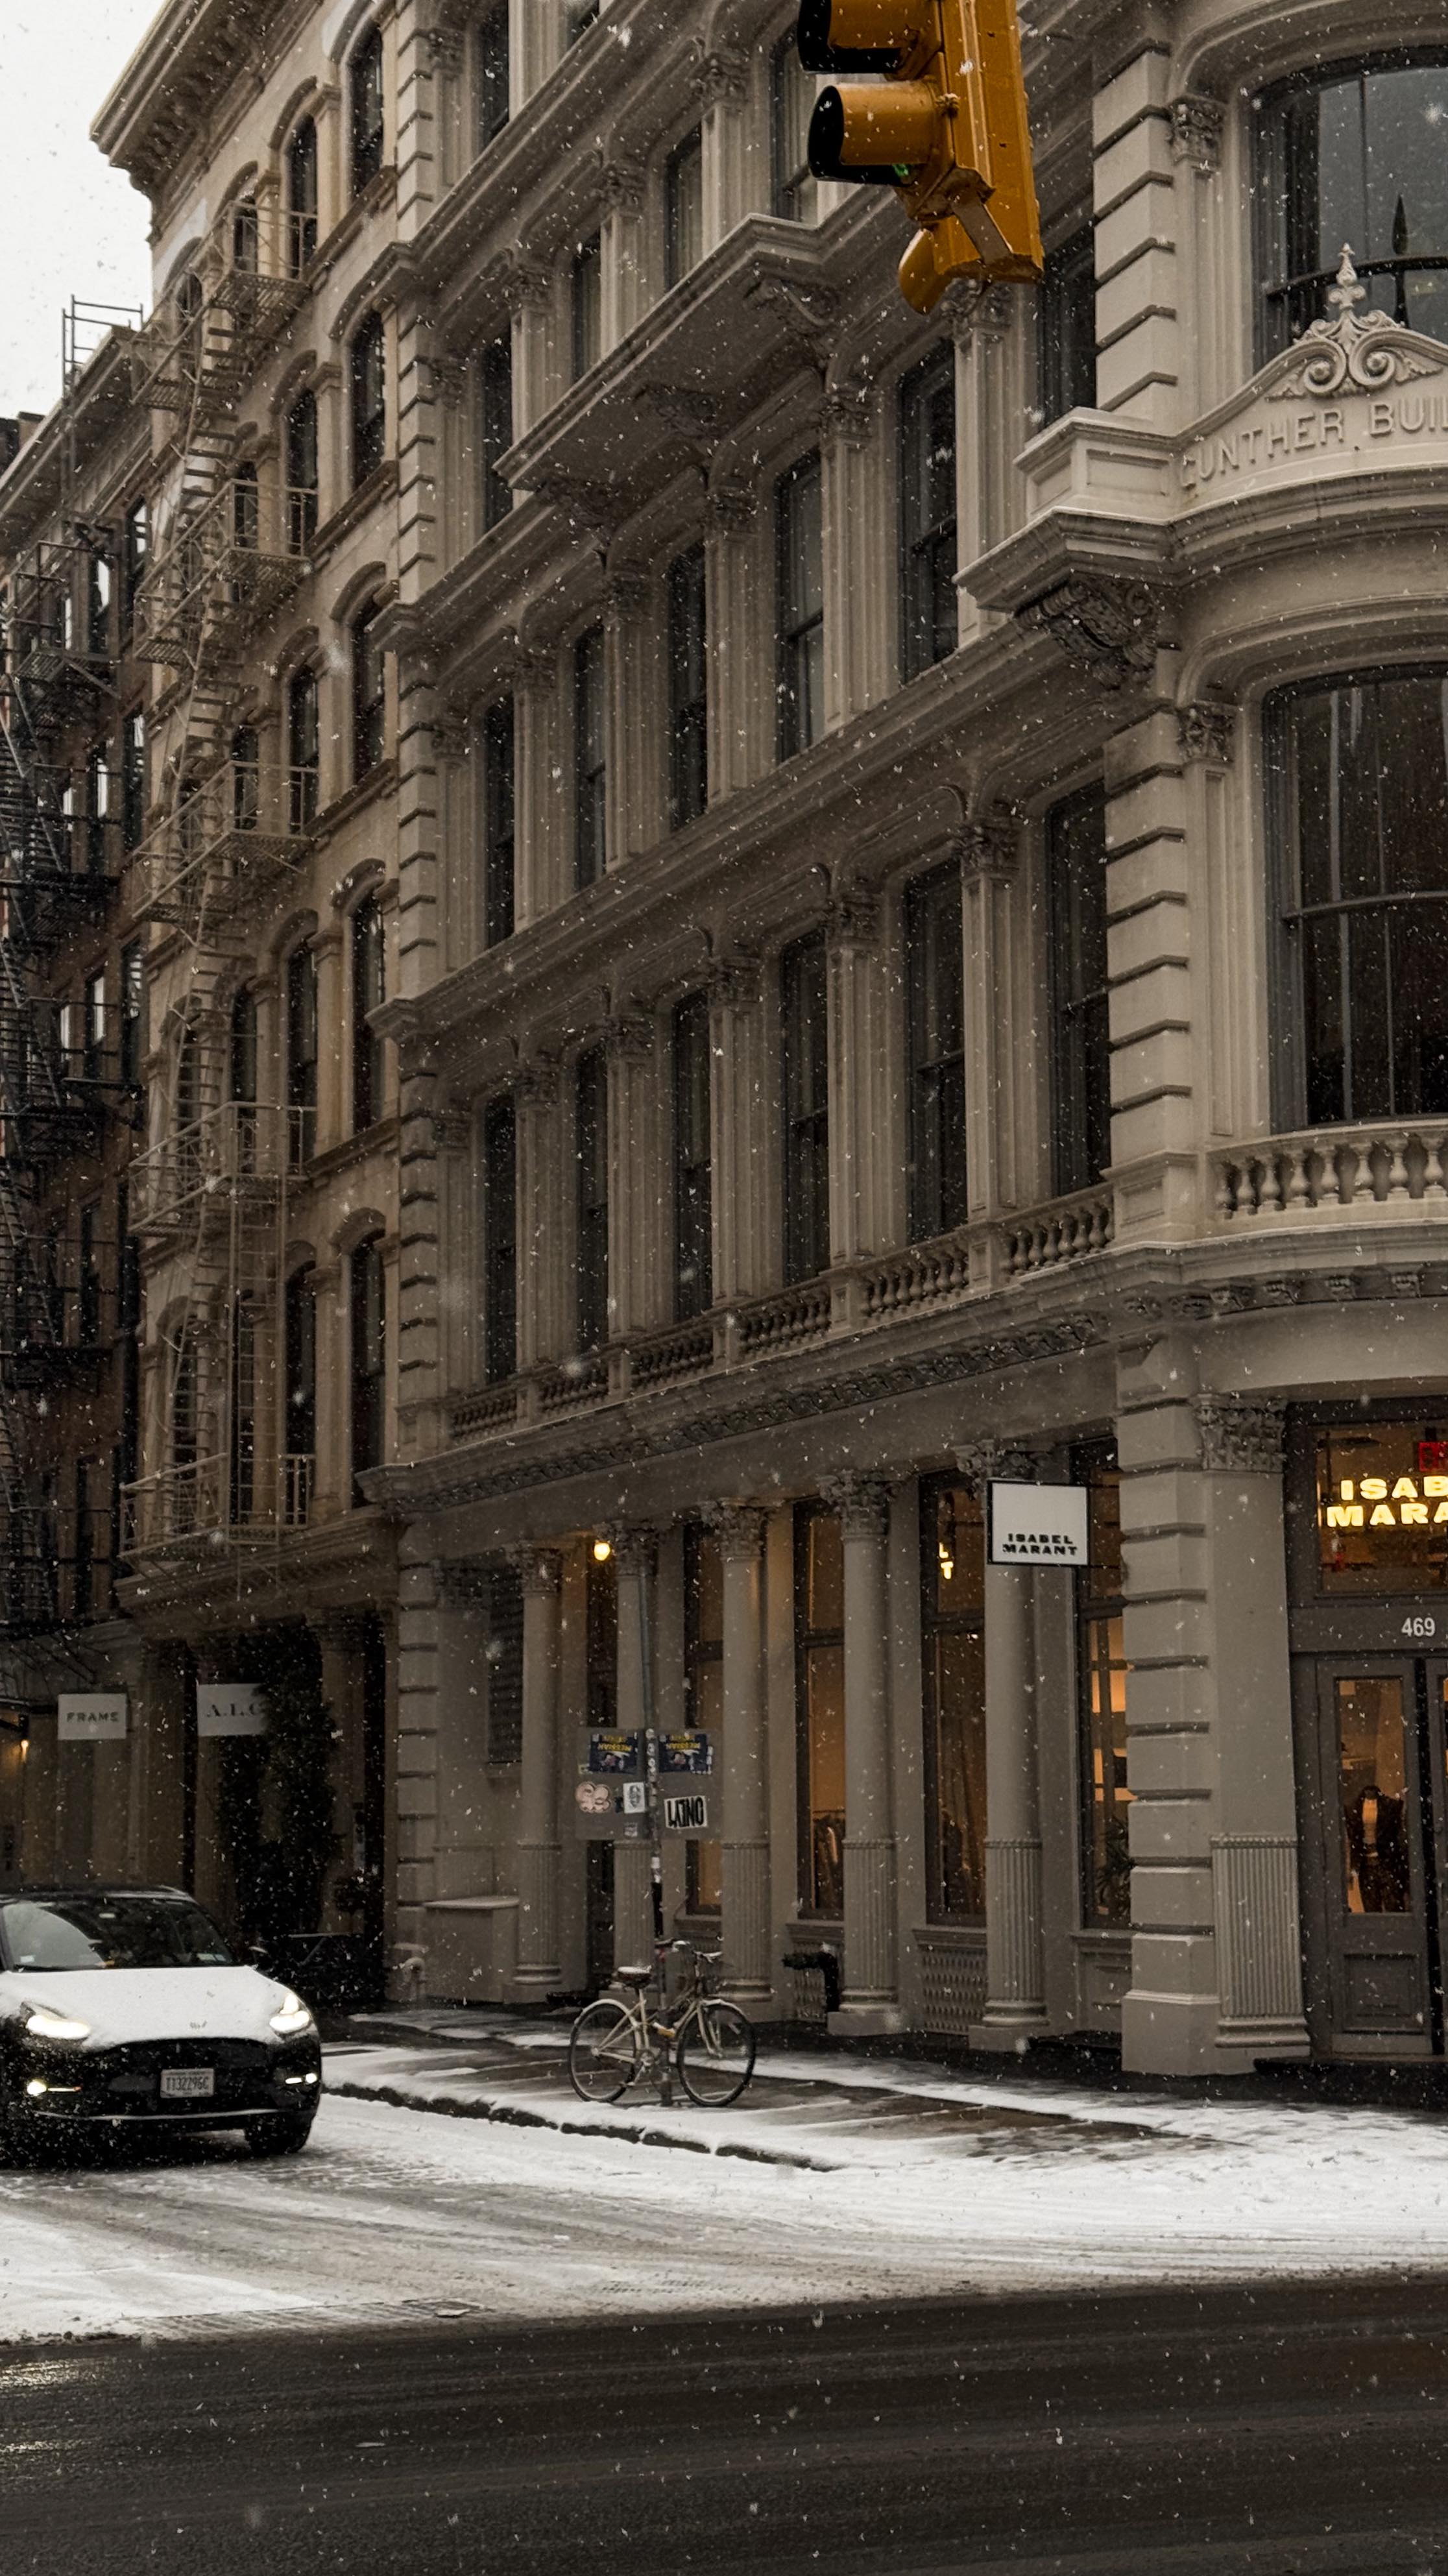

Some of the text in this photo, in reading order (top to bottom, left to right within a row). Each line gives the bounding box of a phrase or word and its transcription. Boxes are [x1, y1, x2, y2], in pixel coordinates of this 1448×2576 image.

[1340, 1476, 1448, 1501] ISAB
[1327, 1501, 1448, 1527] MARA
[1008, 1533, 1073, 1544] ISABEL
[1002, 1544, 1078, 1556] MARANT
[1401, 1617, 1436, 1637] 469
